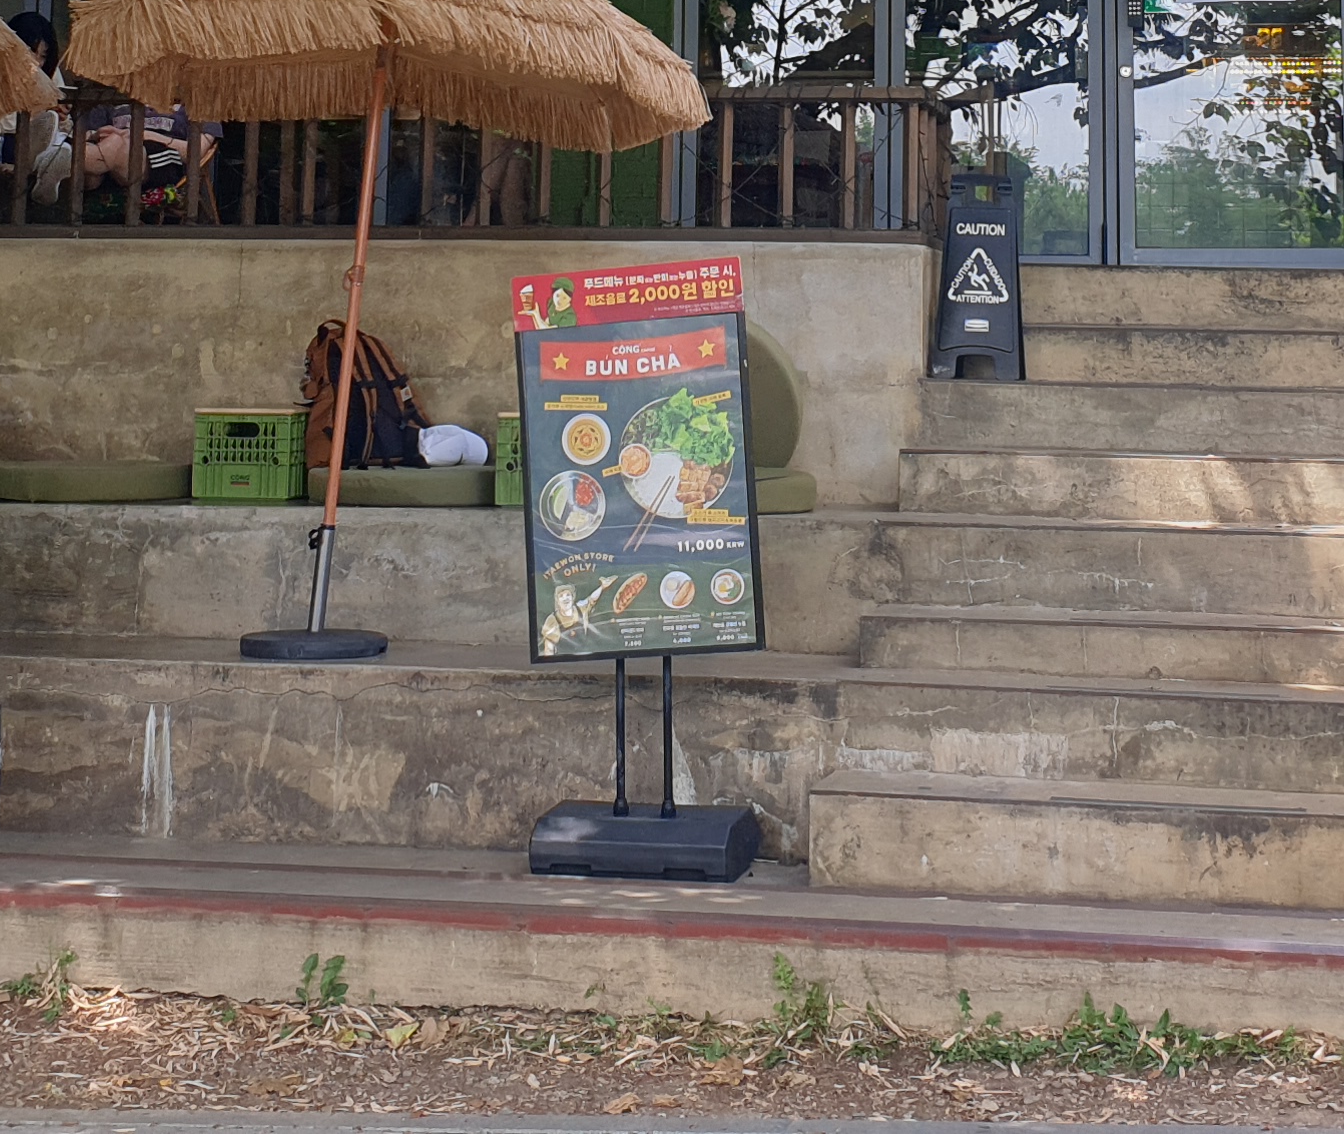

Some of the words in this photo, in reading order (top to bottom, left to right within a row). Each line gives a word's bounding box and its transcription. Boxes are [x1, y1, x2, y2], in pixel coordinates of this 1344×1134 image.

[956, 222, 1006, 236] CAUTION
[584, 275, 624, 289] 푸드메뉴
[699, 266, 720, 279] 주문
[951, 256, 974, 289] CAUTION
[983, 258, 1006, 290] CUIDADO
[585, 292, 627, 306] 제조음료
[629, 282, 698, 305] 2,000원
[701, 279, 735, 298] 할인
[956, 294, 999, 304] ATTENTION
[677, 538, 724, 553] 11,000
[726, 540, 745, 549] KRW
[543, 553, 581, 580] ITAEWON
[583, 552, 615, 563] STORE
[563, 562, 597, 578] ONLY!
